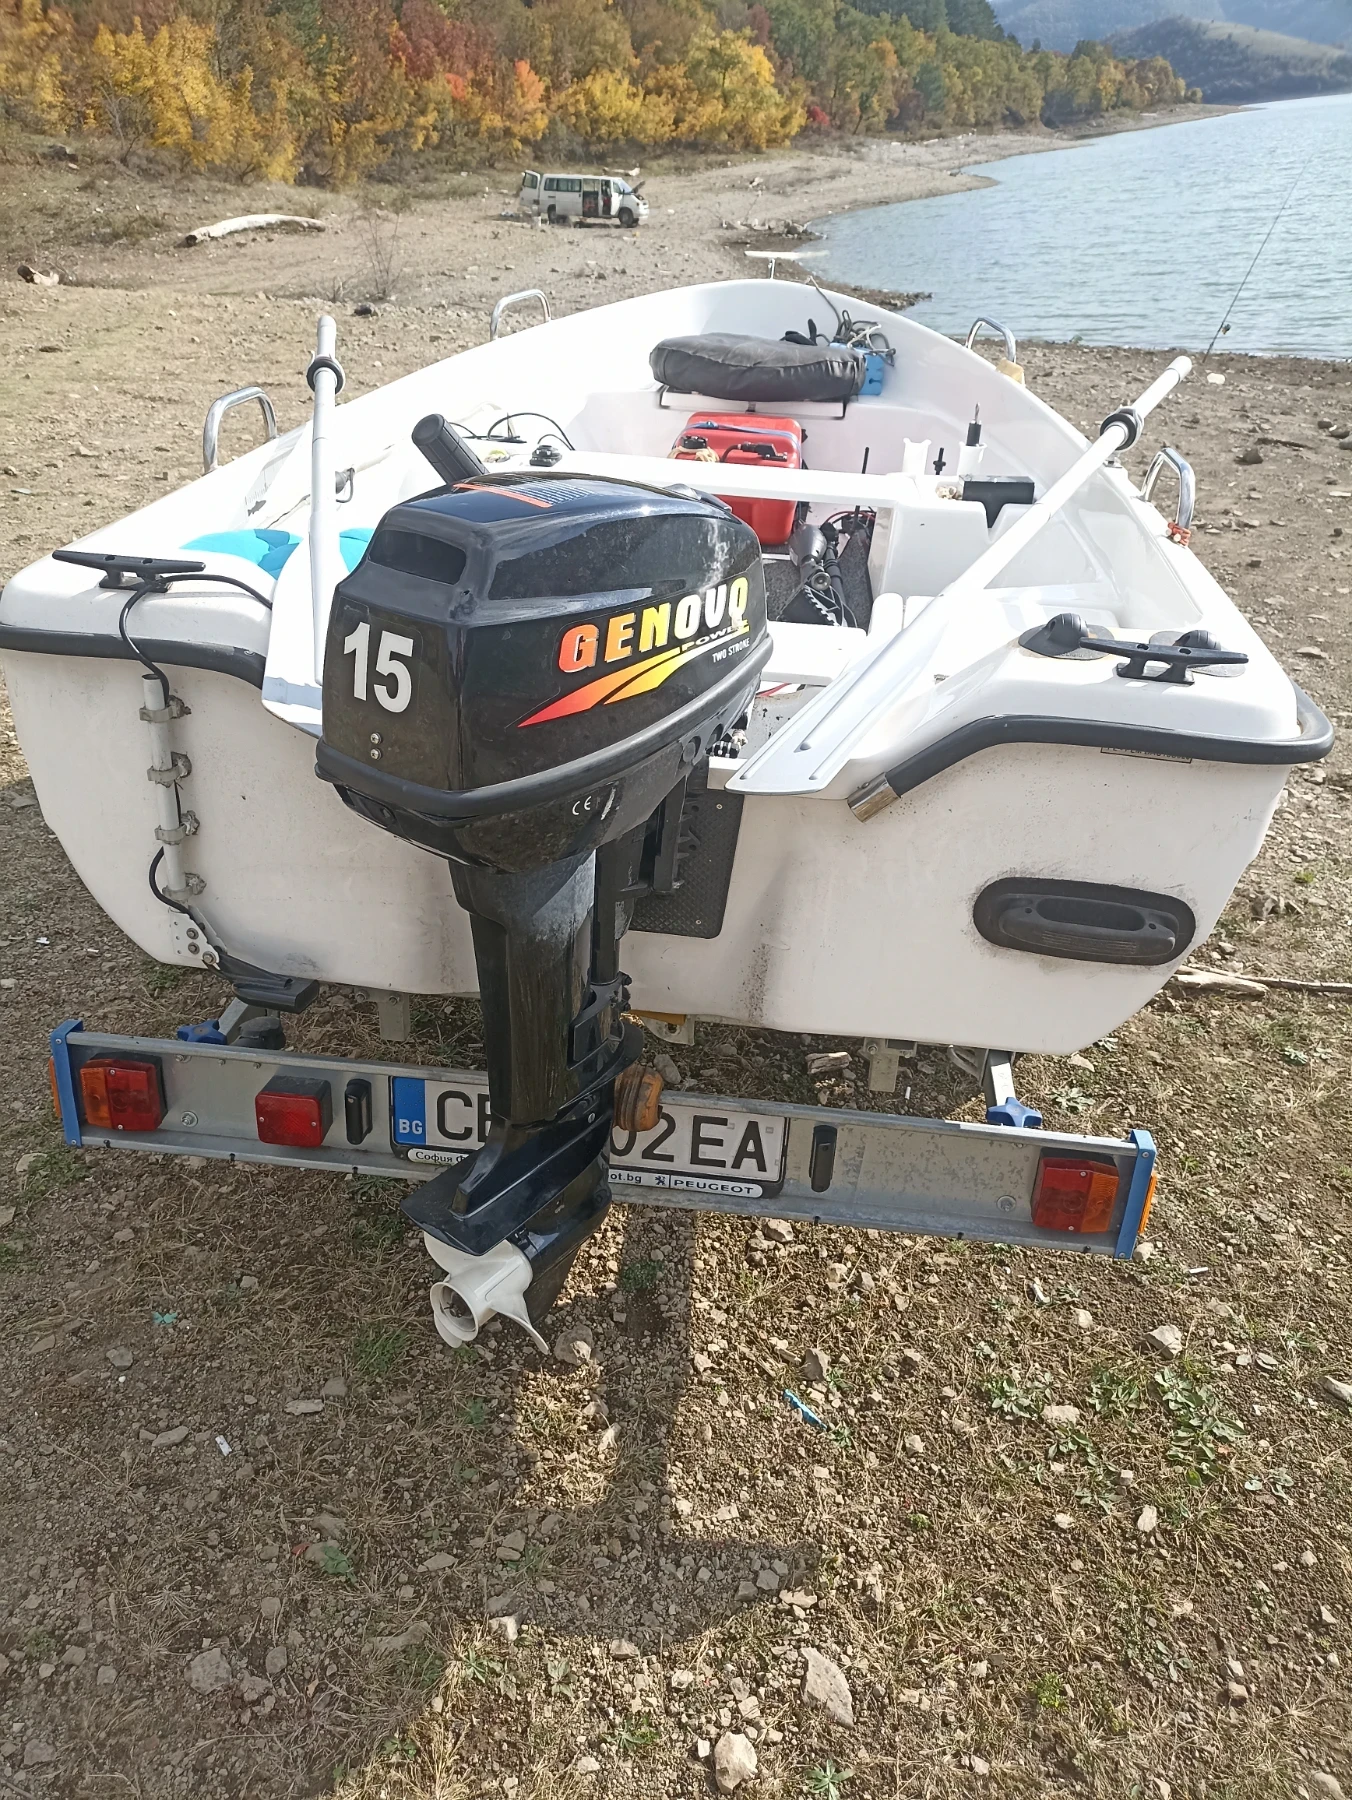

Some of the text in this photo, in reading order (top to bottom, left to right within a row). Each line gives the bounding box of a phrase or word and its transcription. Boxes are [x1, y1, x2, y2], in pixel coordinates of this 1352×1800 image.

[681, 620, 748, 652] POWE
[712, 638, 750, 663] TWO STROKE
[343, 621, 414, 713] 15
[571, 795, 592, 816] CE
[398, 1118, 423, 1135] BG
[689, 1114, 768, 1173] EA
[415, 1151, 453, 1163] София
[607, 1172, 642, 1184] ot.bg
[673, 1179, 754, 1195] PEUGEOT
